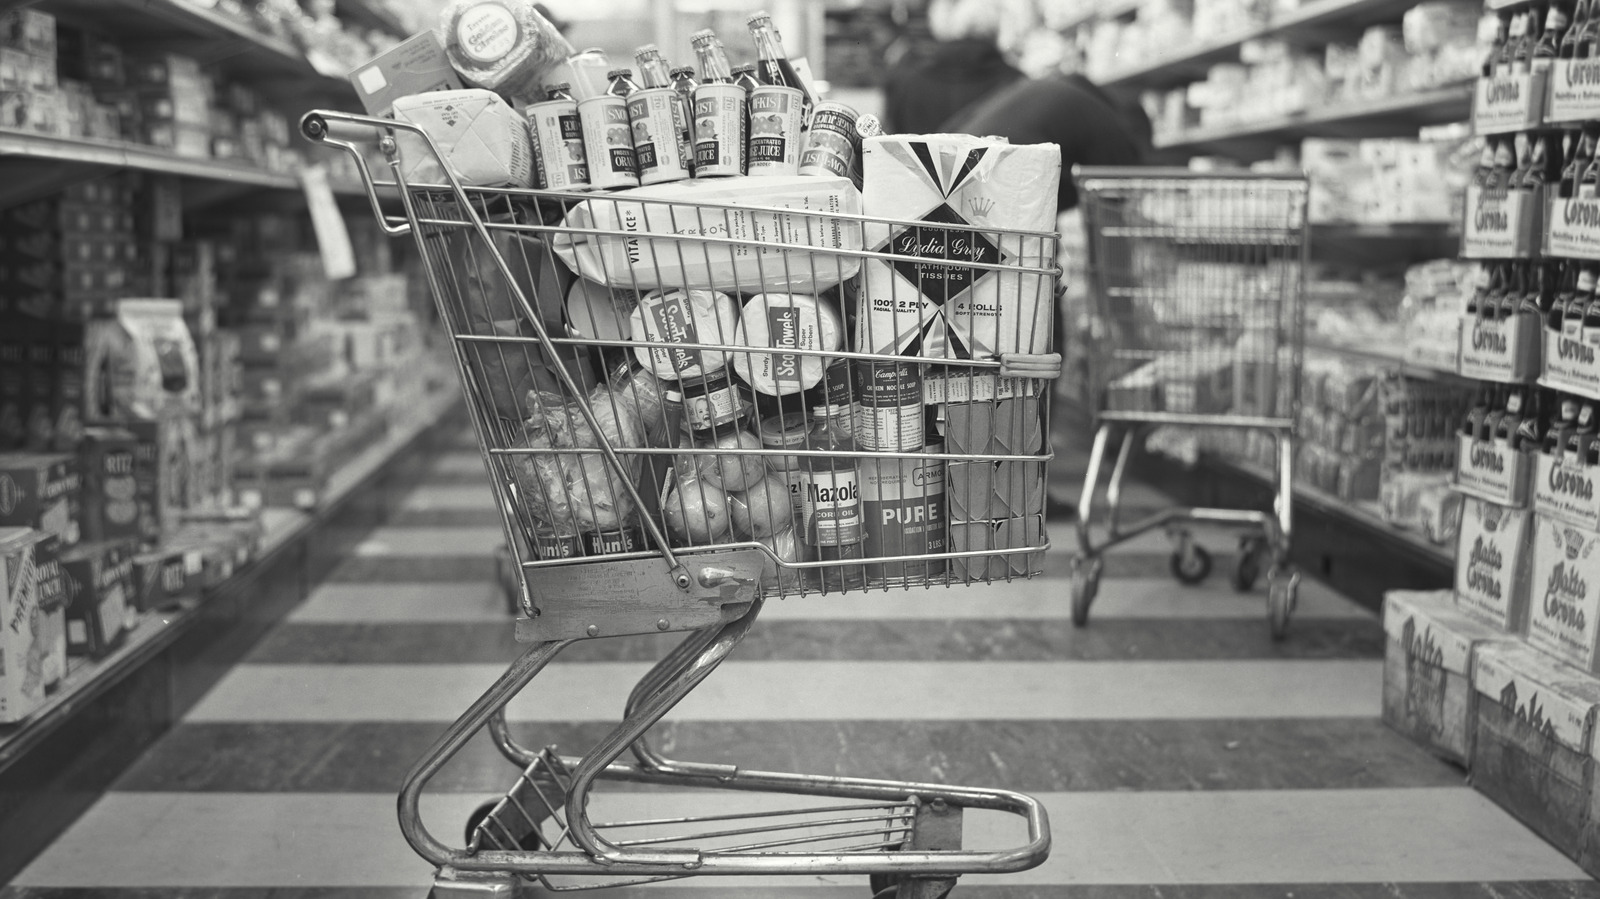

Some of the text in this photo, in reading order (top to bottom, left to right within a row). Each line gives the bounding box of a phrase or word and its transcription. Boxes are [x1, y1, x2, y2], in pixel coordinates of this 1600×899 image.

[1566, 57, 1600, 88] Coron
[758, 146, 781, 157] JUICE
[1563, 197, 1600, 229] Coron
[626, 216, 640, 264] VITAICE
[899, 236, 945, 258] Lydia
[776, 311, 796, 377] ScoTowels
[875, 367, 908, 379] Campell's
[105, 453, 134, 474] RITZ
[917, 470, 943, 480] ARMO
[1549, 460, 1593, 501] Corona
[807, 481, 858, 503] Mazola
[841, 509, 854, 517] OIL
[882, 503, 938, 526] PURE
[540, 541, 569, 557] unt's
[928, 541, 933, 549] 3
[1543, 589, 1586, 631] Corona
